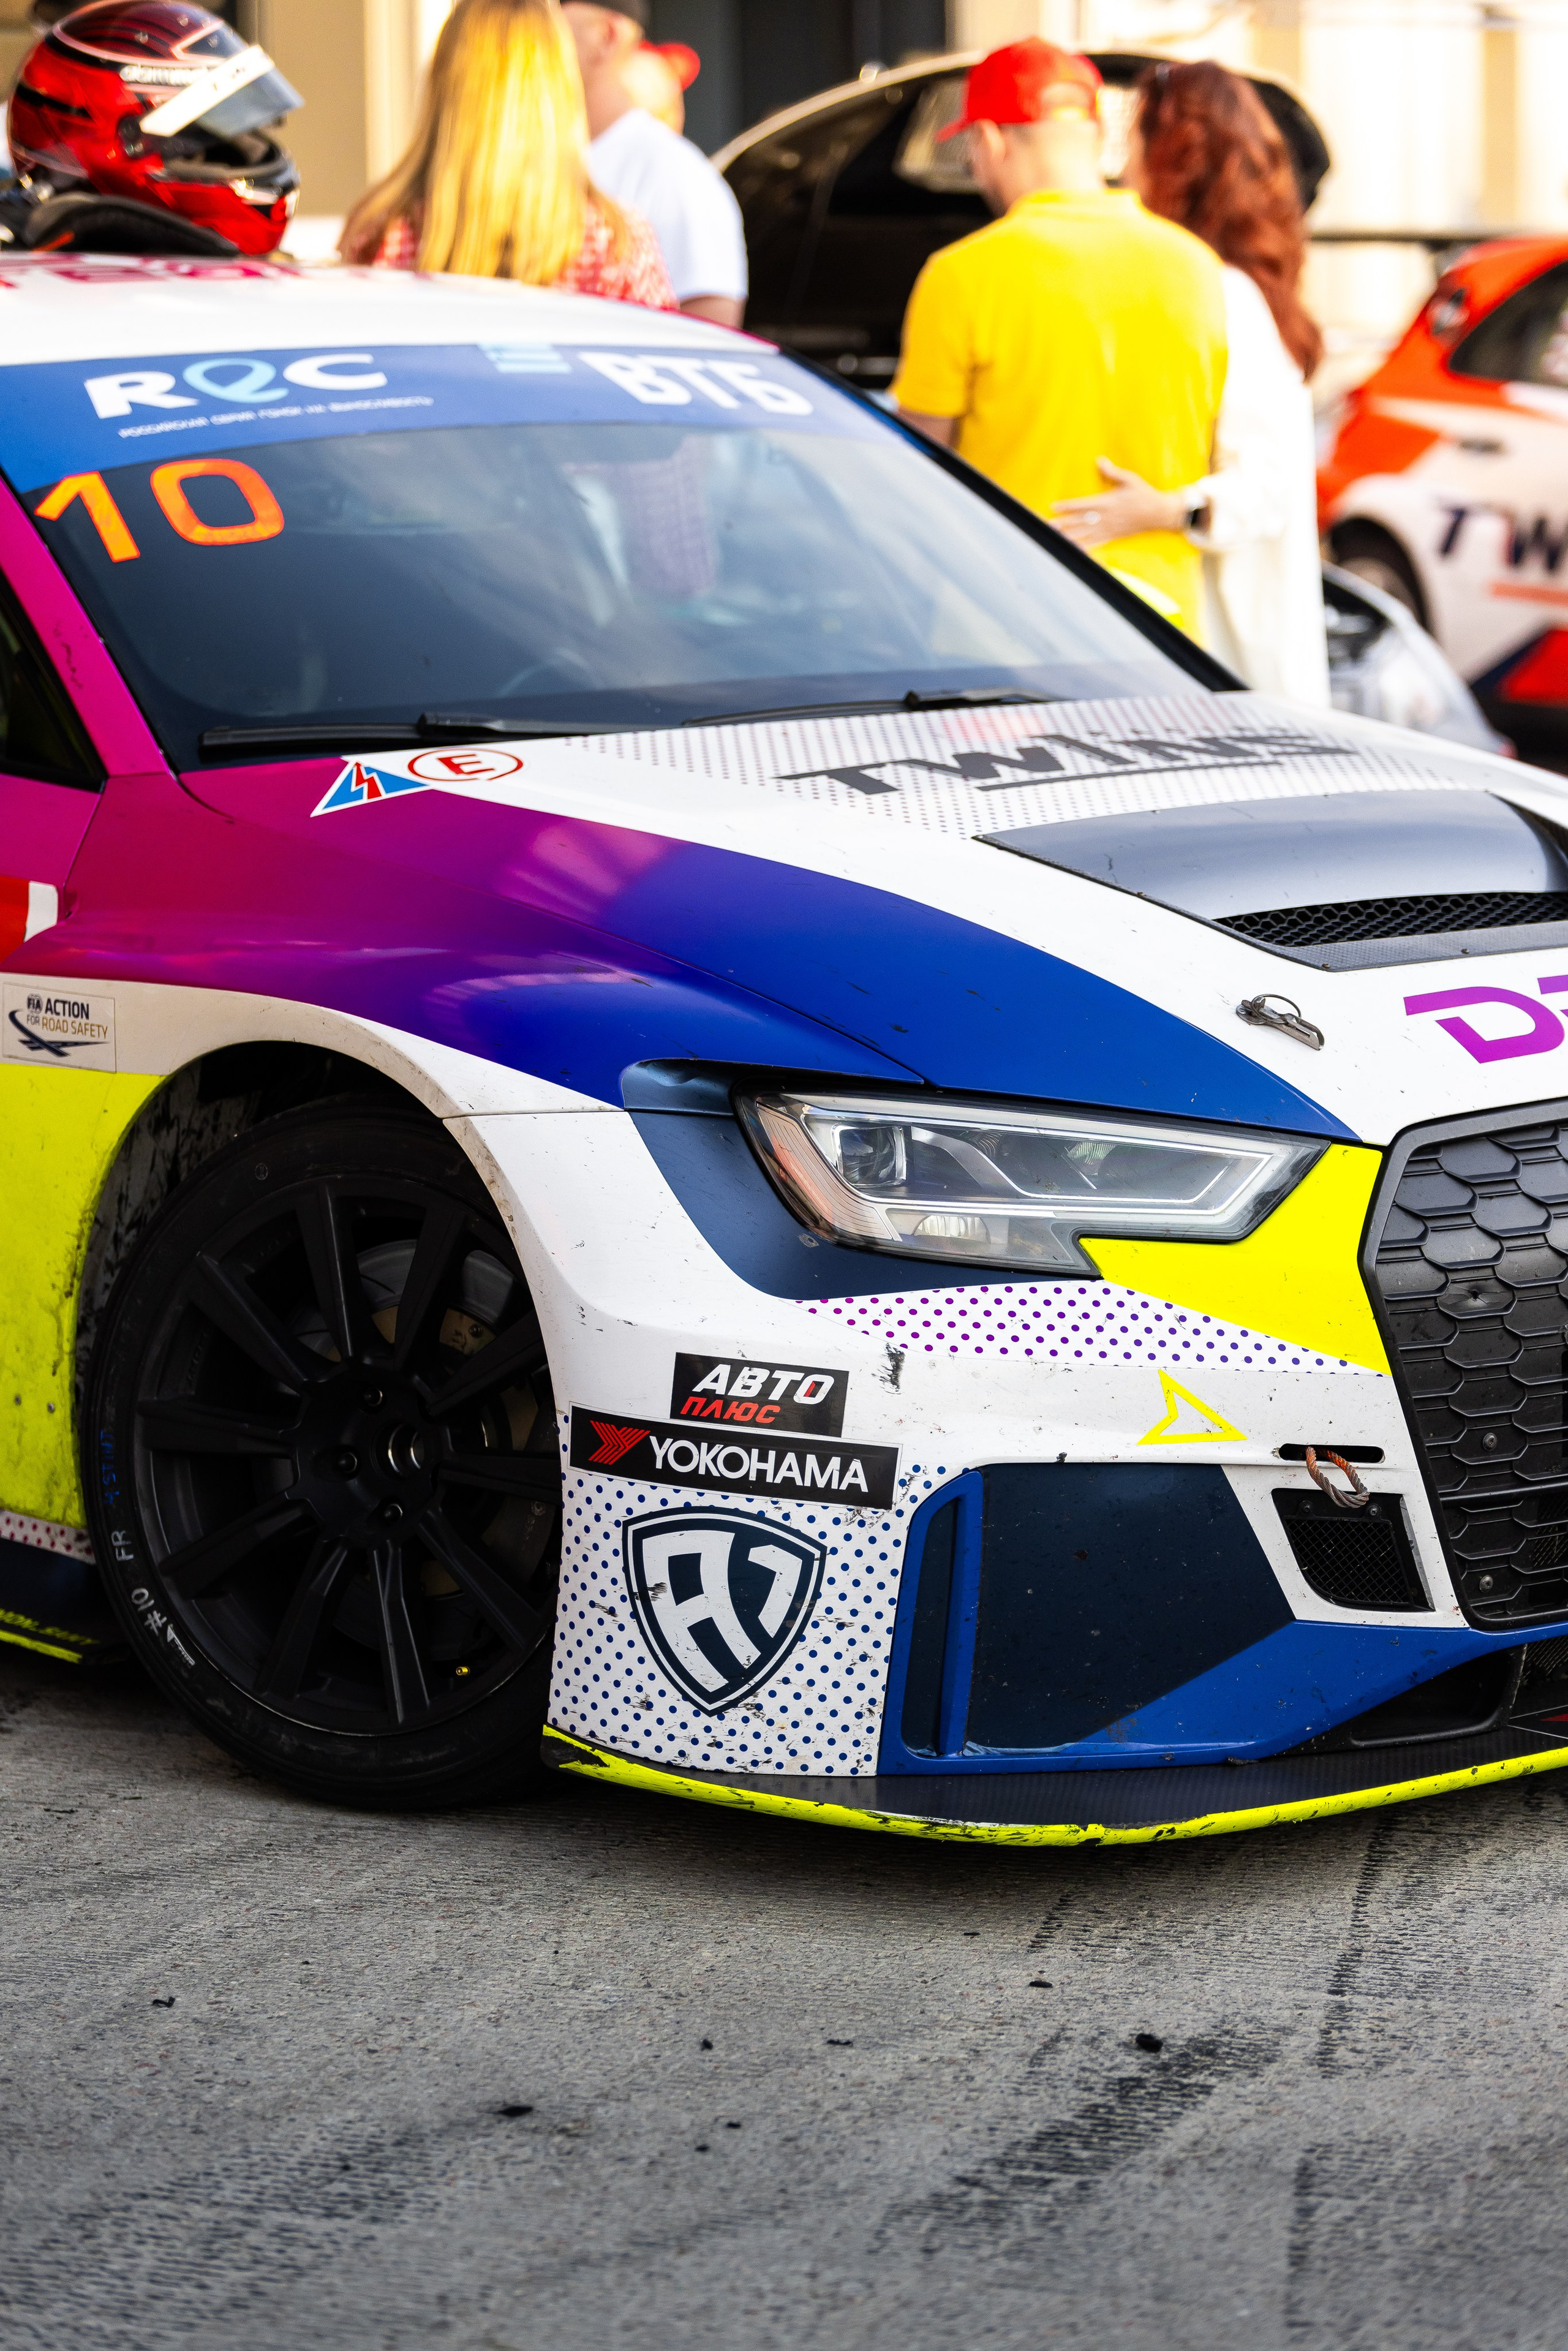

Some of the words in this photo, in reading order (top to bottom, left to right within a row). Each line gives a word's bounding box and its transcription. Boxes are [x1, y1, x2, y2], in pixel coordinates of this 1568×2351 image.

[34, 458, 285, 564] 10
[437, 753, 496, 775] E
[775, 734, 1357, 795] TWINS
[26, 1014, 40, 1025] FOR
[42, 1016, 69, 1033] ROAD
[70, 1021, 108, 1038] SAFETY
[45, 998, 89, 1020] ACTION
[692, 1364, 835, 1405] АВТО
[680, 1395, 781, 1424] ПЛЮС
[649, 1435, 869, 1493] YOKOHAMA
[111, 1530, 134, 1561] FR
[131, 1587, 167, 1636] #10
